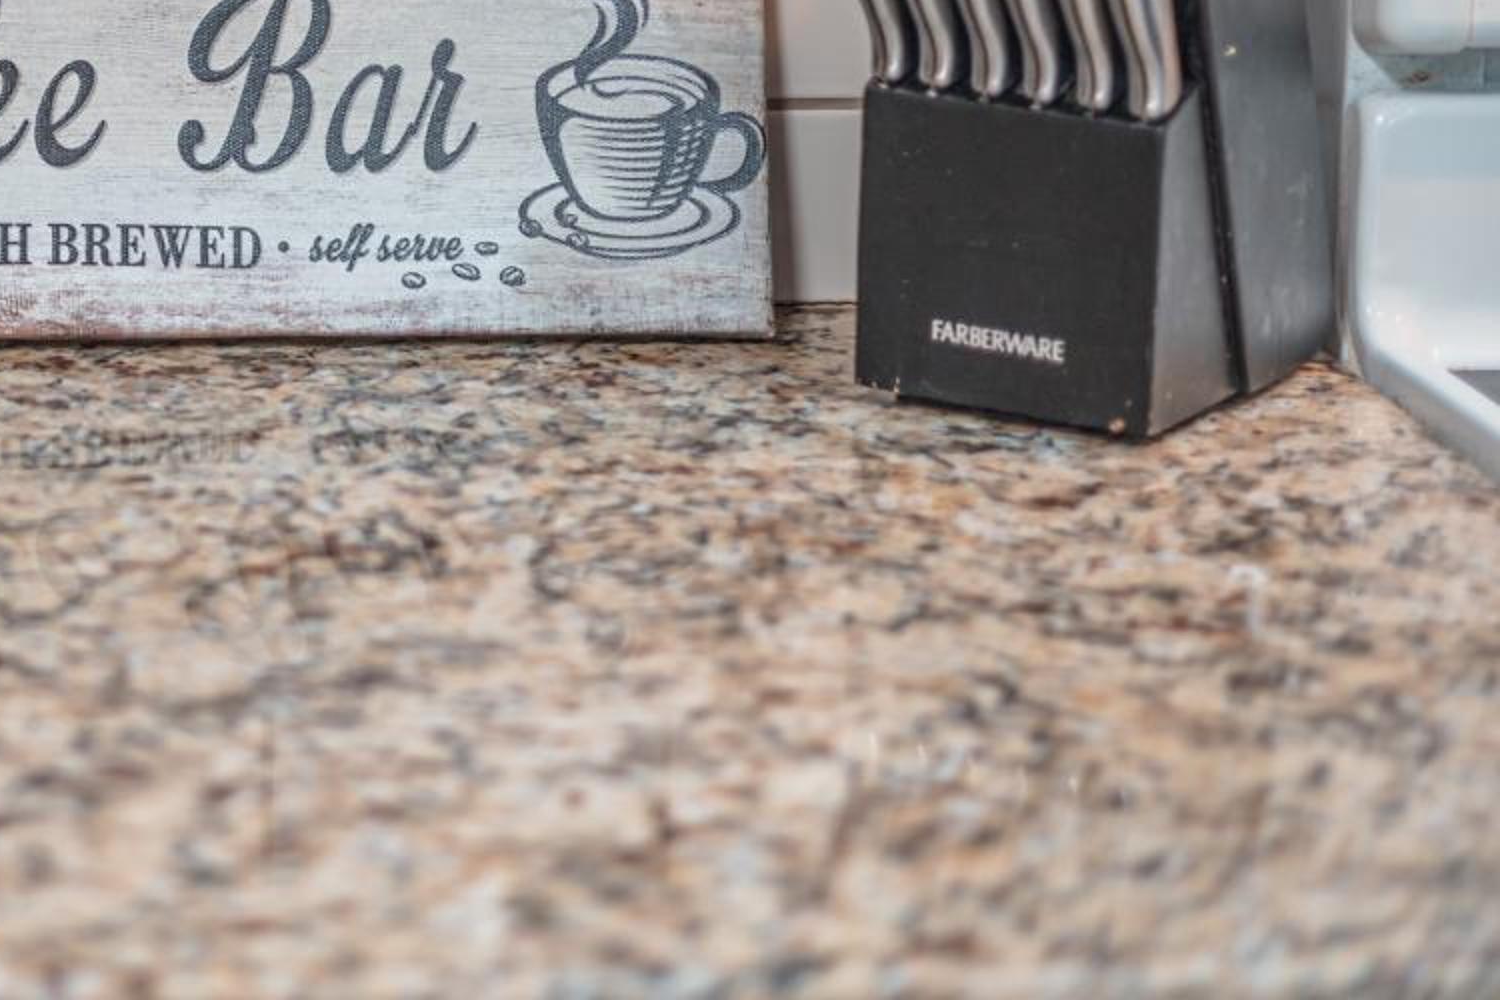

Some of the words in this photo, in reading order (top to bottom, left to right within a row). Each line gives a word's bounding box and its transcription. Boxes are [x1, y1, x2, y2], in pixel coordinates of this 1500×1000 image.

[47, 222, 262, 269] BREWED
[308, 223, 376, 272] self
[379, 235, 465, 263] serve
[930, 318, 1067, 364] FARBERWARE
